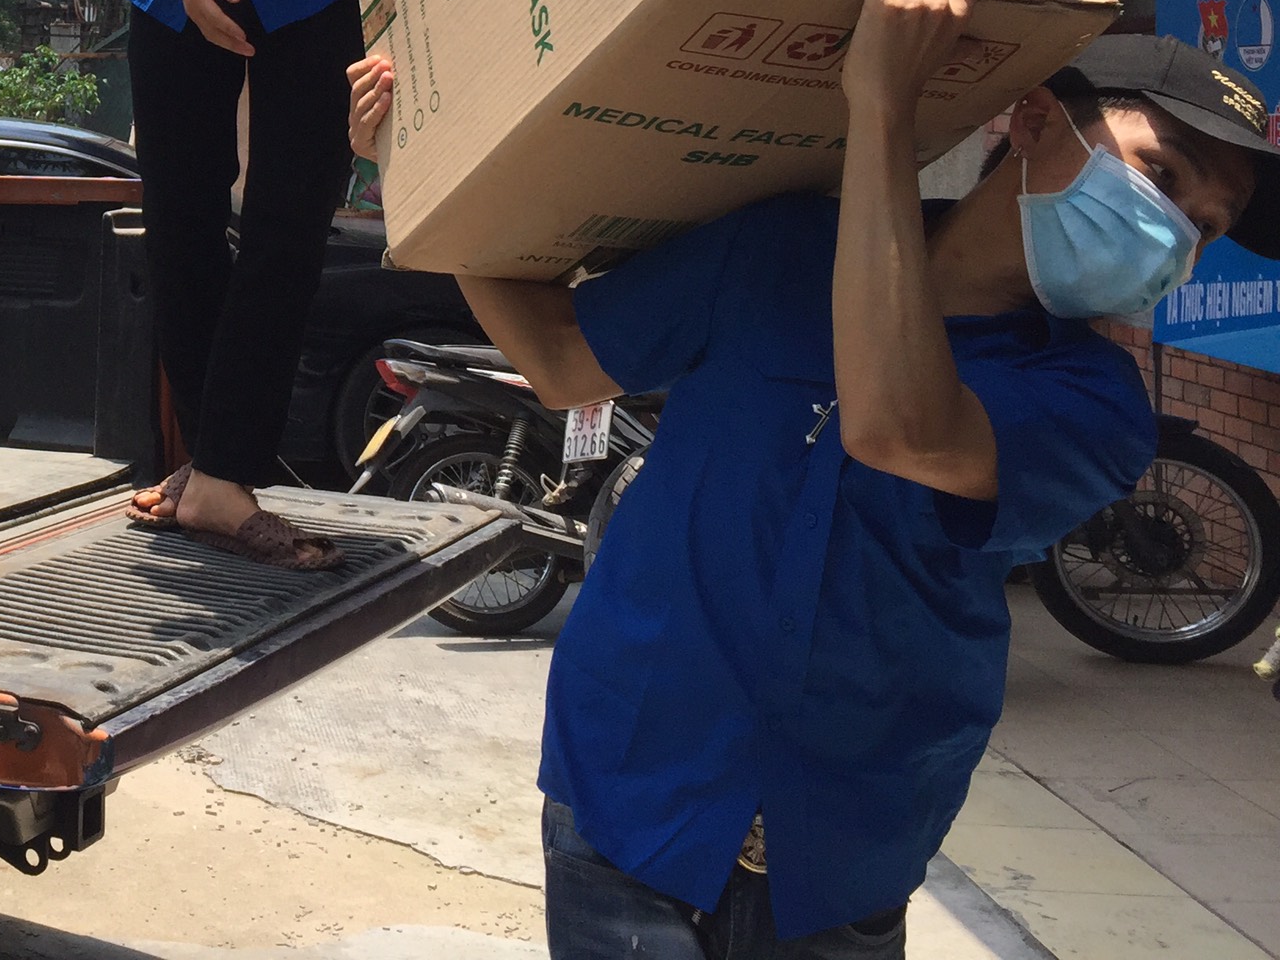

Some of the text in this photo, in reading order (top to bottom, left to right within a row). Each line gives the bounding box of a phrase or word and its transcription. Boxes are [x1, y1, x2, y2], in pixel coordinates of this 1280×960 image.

[665, 60, 733, 77] COVER
[562, 102, 724, 141] MEDICAL
[730, 128, 825, 149] FACE
[680, 149, 760, 169] SHB
[565, 431, 606, 458] 312.66
